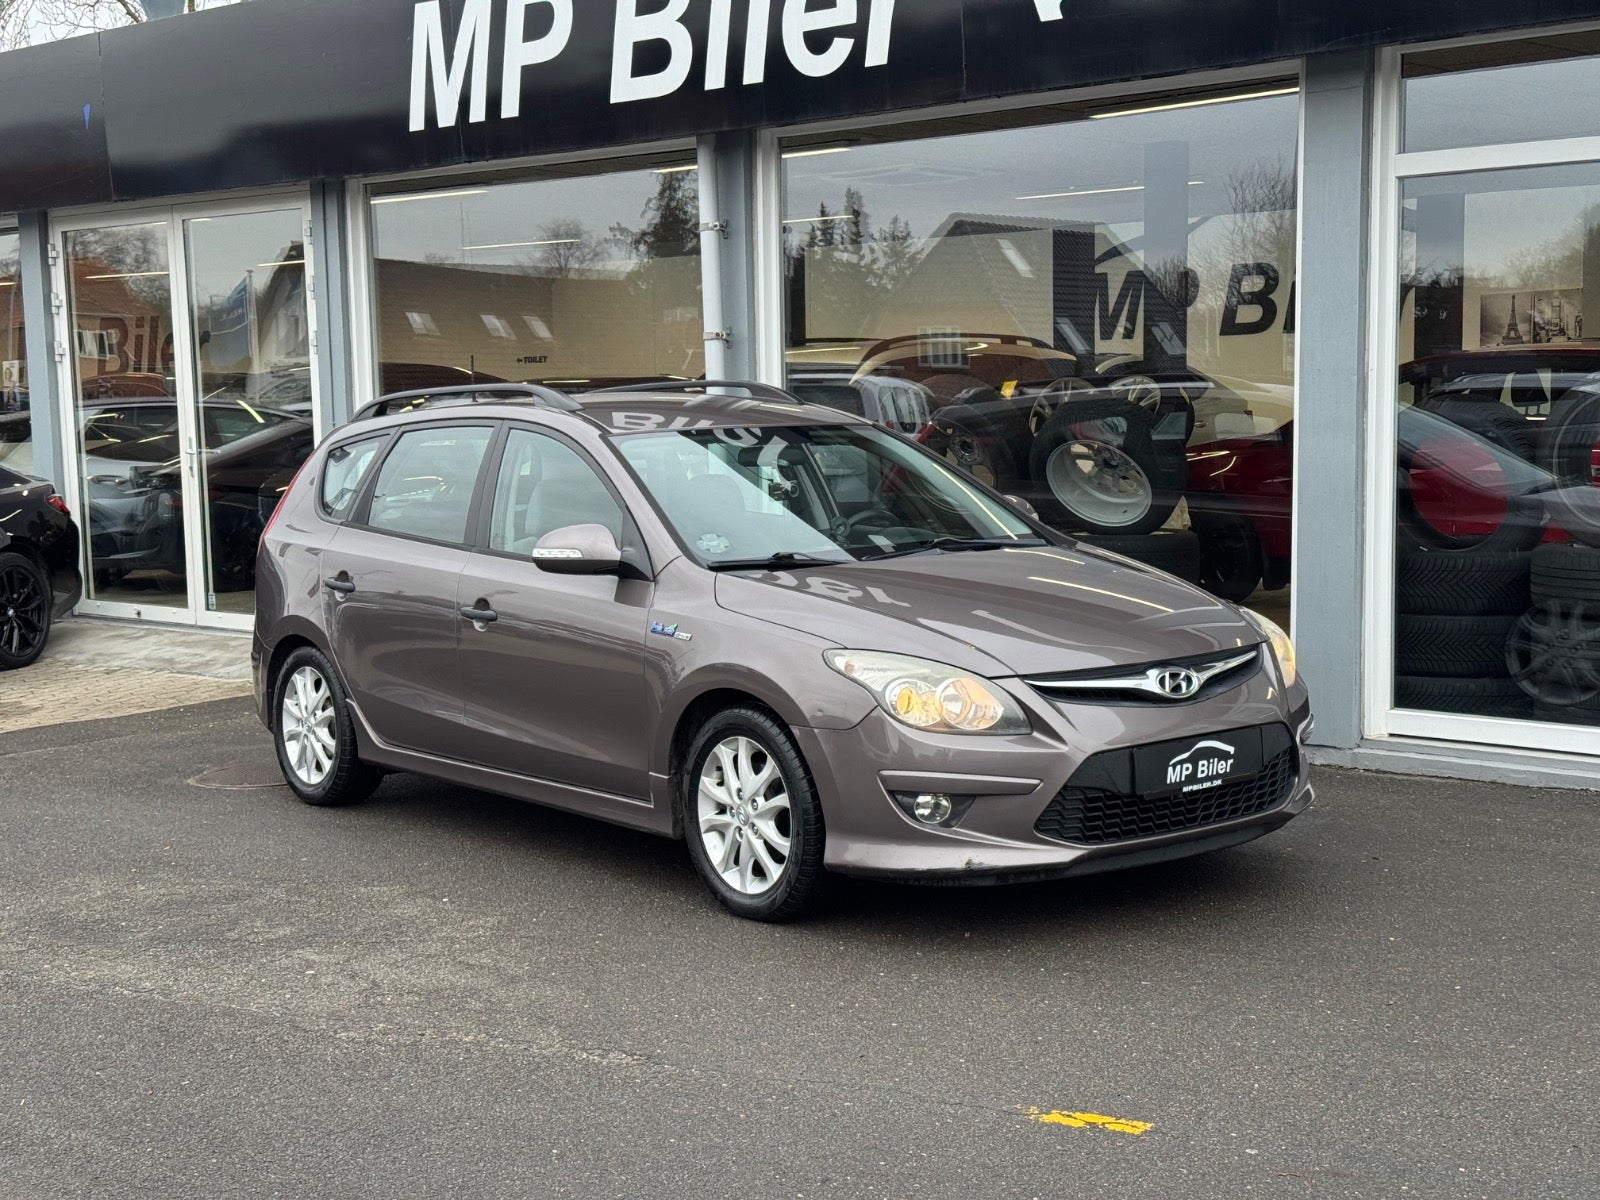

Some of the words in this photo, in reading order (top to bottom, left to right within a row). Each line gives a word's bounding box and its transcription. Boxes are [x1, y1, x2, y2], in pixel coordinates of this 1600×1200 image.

[408, 0, 574, 132] MP
[523, 355, 548, 364] TOILET
[1167, 763, 1193, 784] MP
[1197, 758, 1234, 778] Biler
[1183, 780, 1222, 792] MPBILER.DK
